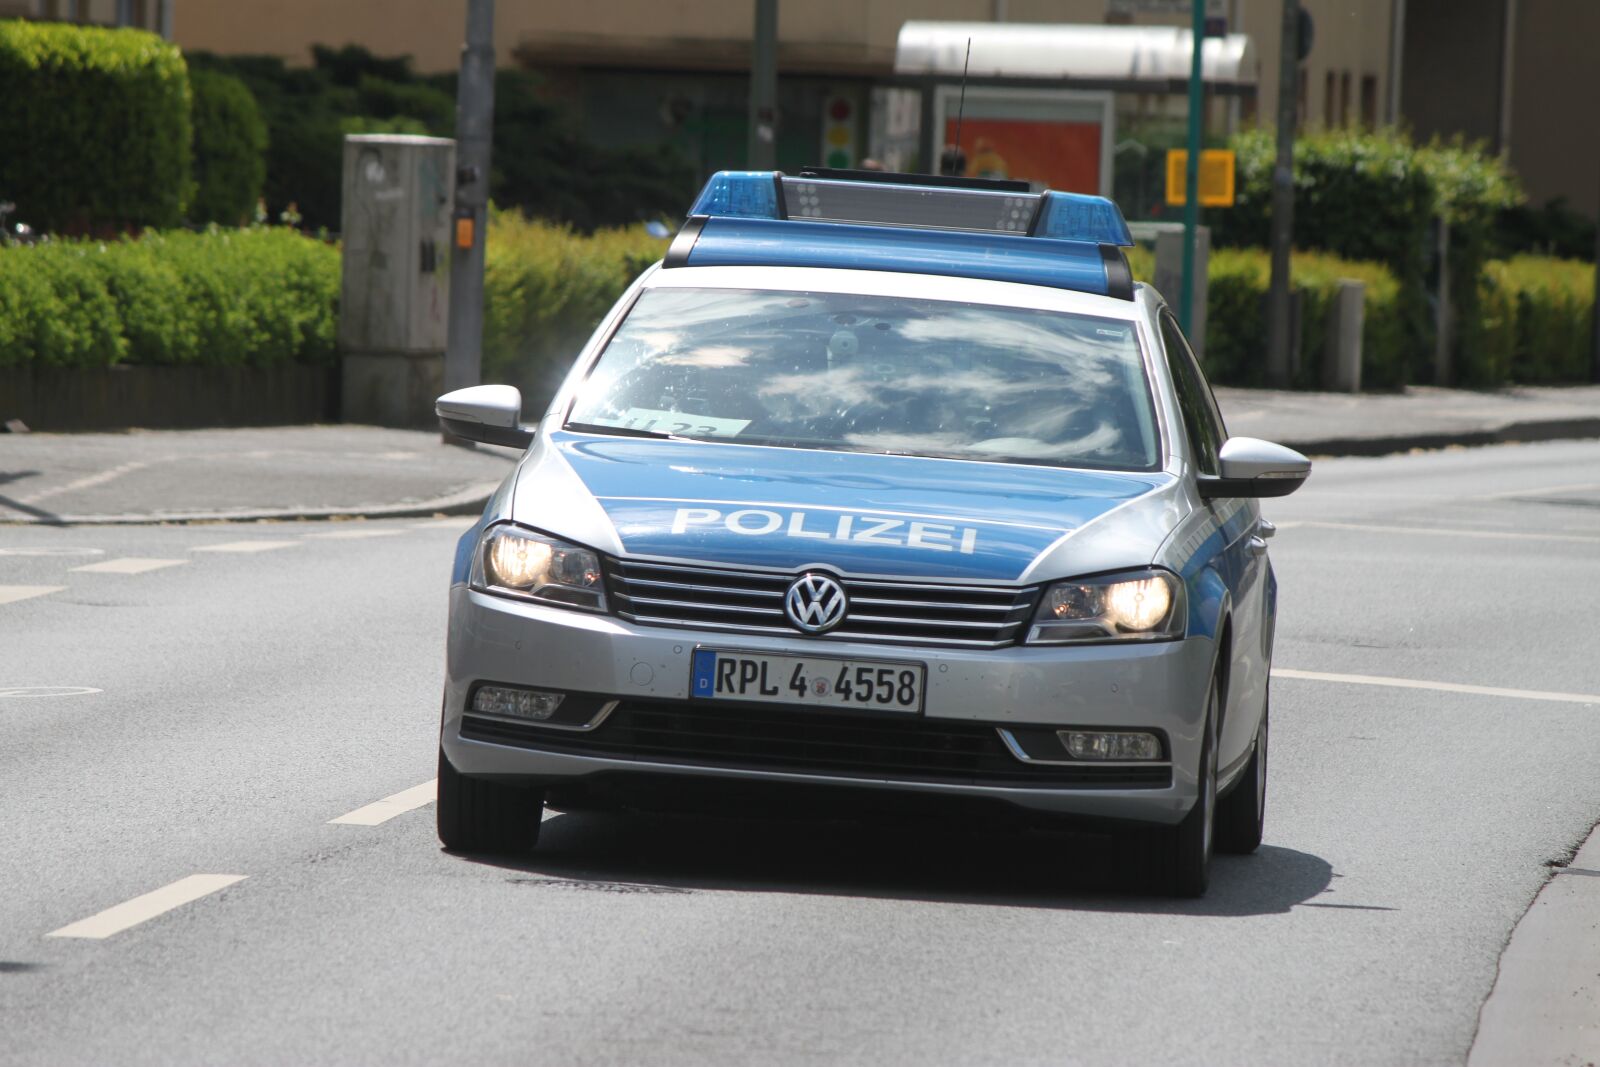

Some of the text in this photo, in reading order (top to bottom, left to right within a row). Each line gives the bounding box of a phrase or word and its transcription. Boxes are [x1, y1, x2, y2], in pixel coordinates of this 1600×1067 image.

[671, 508, 977, 554] POLIZEI
[716, 657, 916, 706] RPL 4 4558
